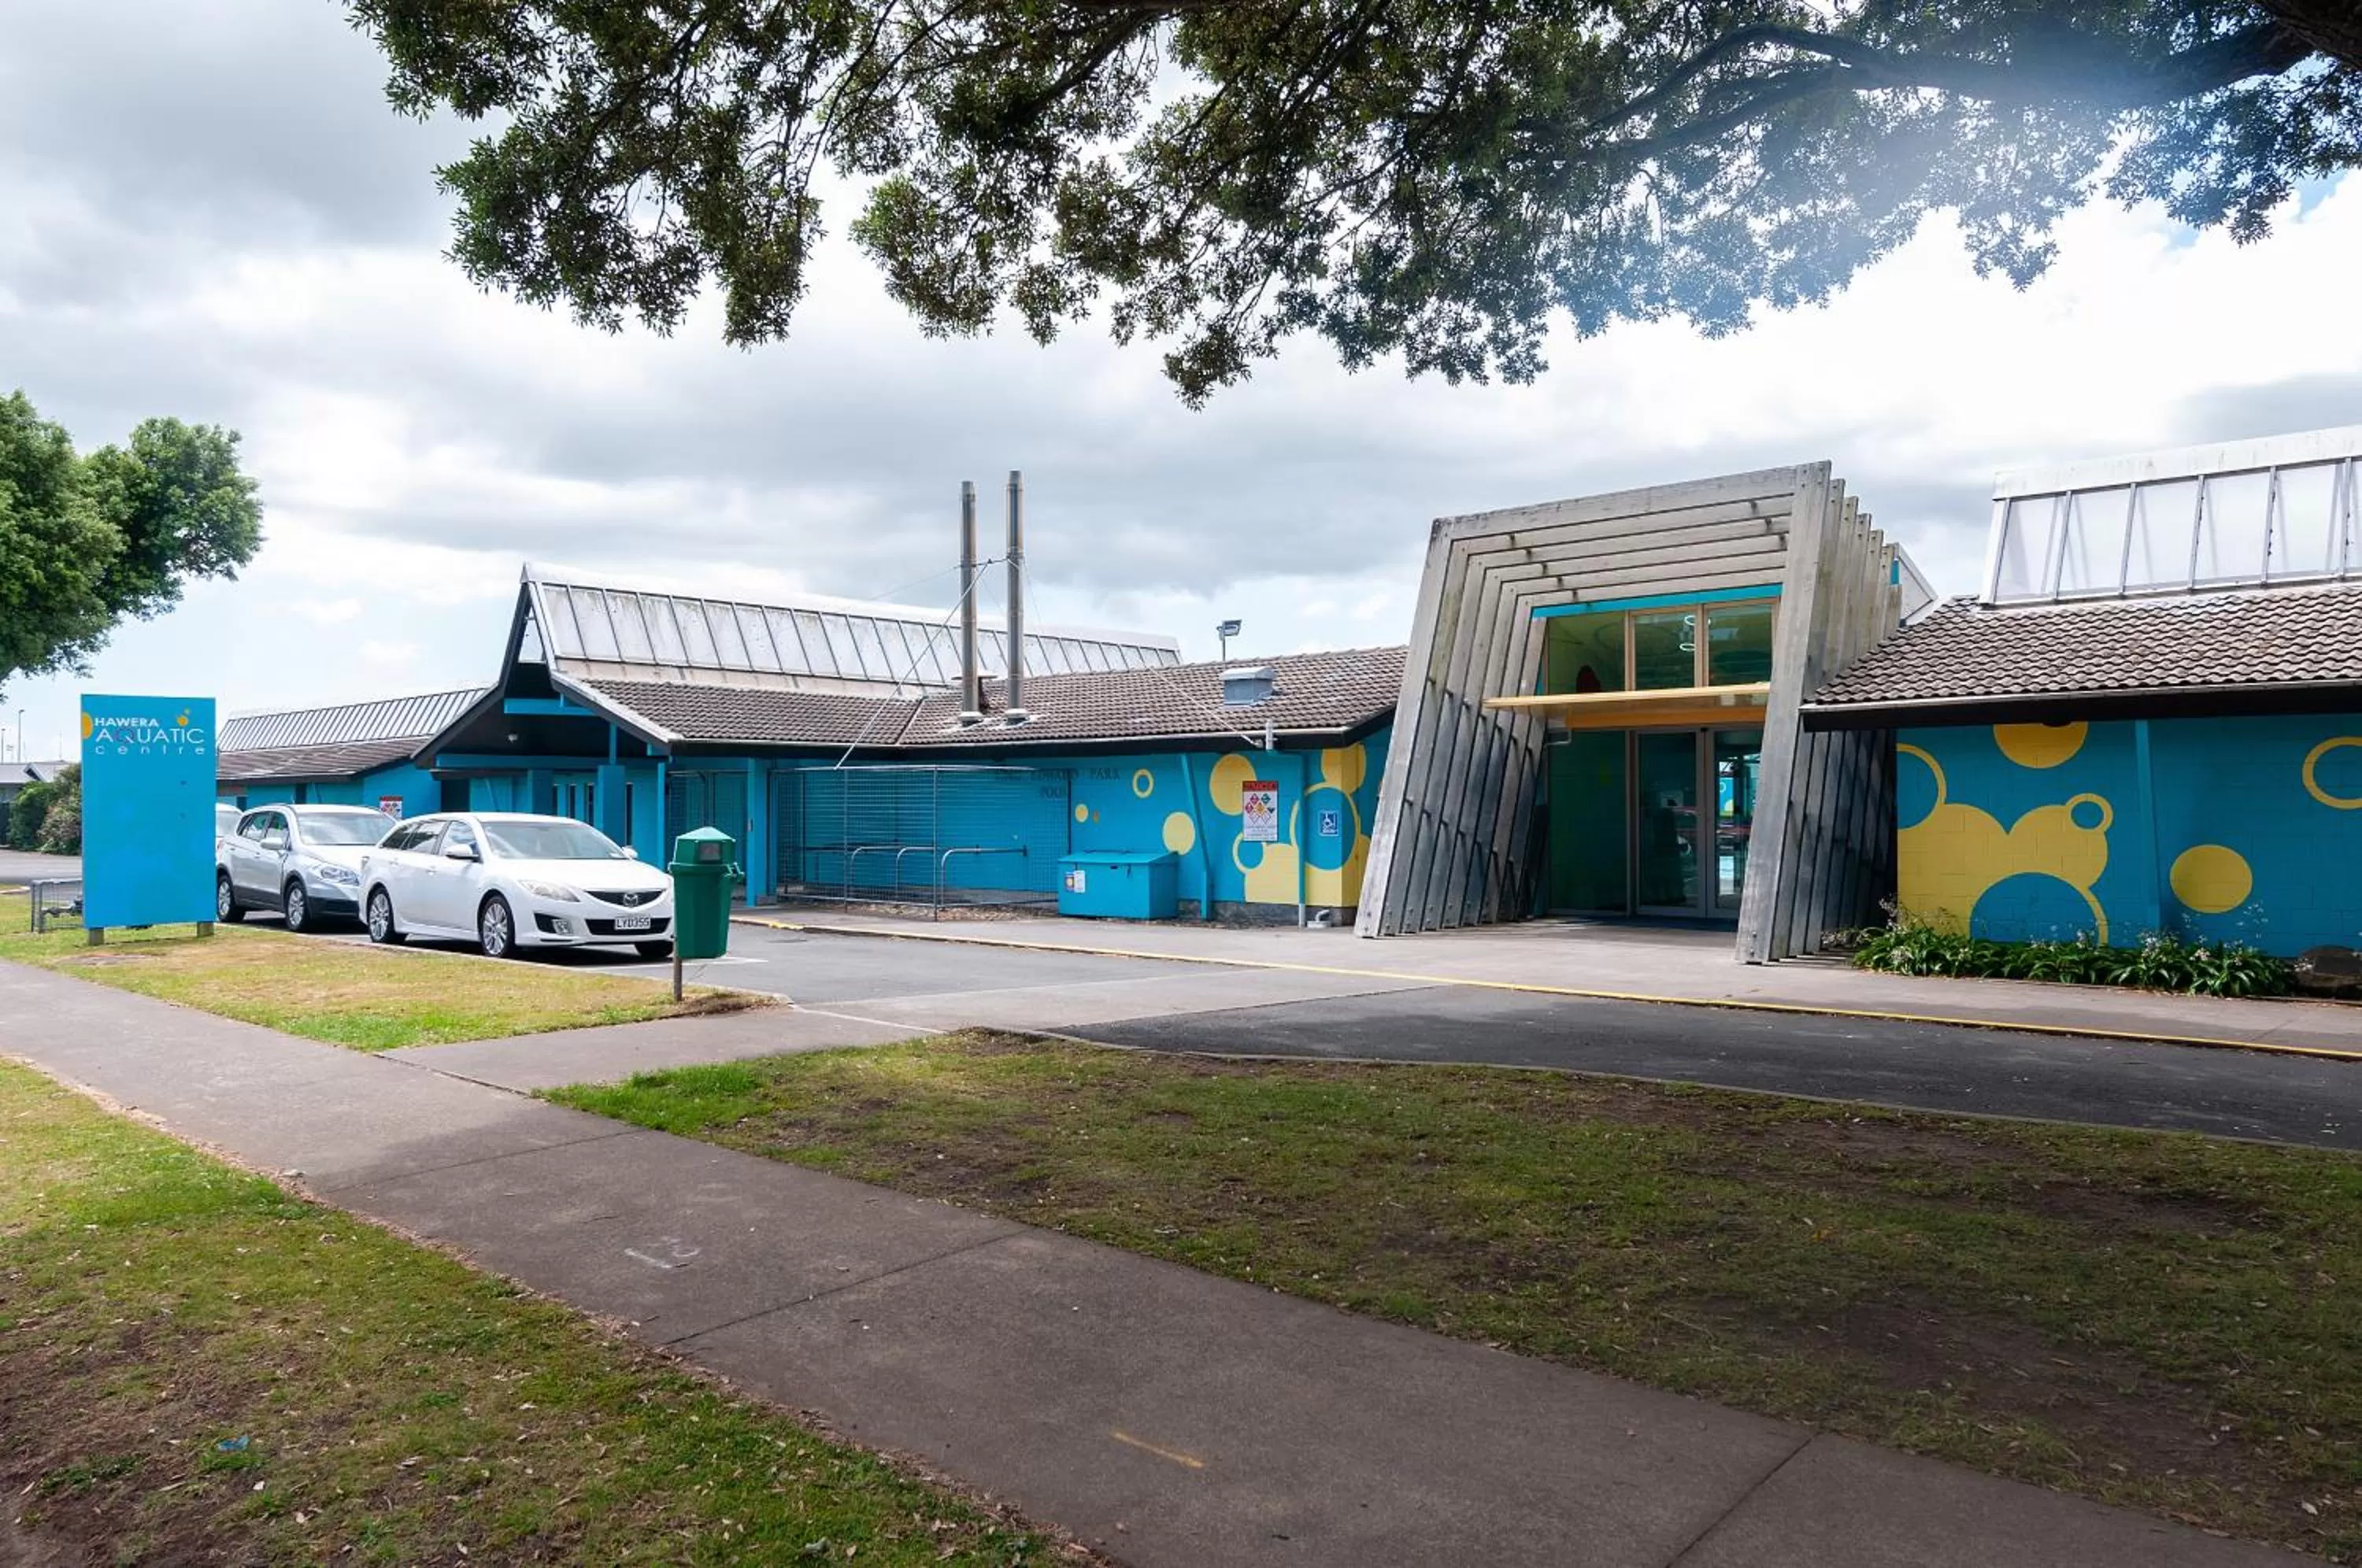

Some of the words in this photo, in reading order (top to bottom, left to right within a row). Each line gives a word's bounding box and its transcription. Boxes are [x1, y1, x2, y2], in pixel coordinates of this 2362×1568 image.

[94, 717, 160, 727] HAWERA
[95, 727, 205, 745] AQUATIC
[94, 745, 205, 756] centre
